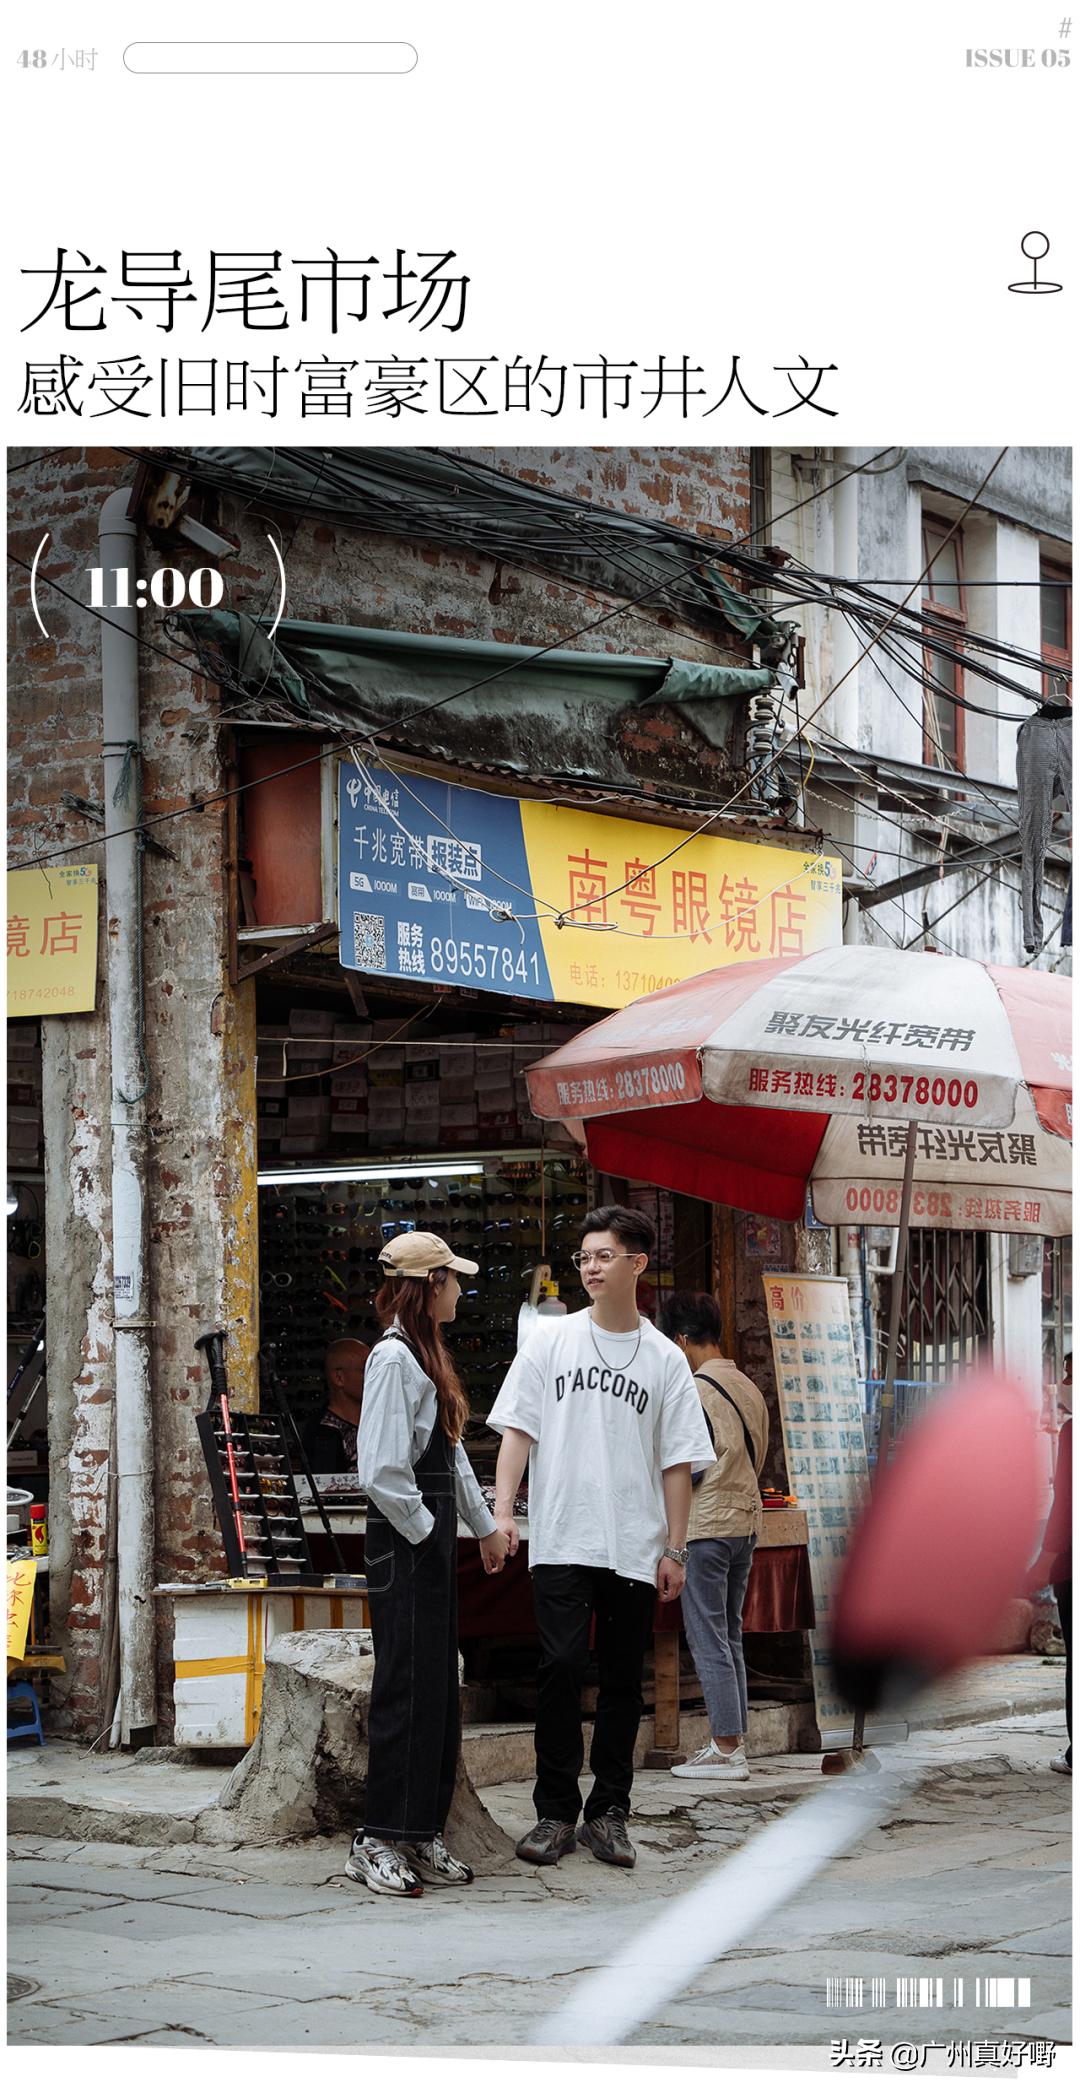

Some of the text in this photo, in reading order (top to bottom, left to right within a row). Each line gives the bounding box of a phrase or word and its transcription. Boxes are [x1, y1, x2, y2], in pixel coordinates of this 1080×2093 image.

[354, 876, 364, 887] 5G
[373, 880, 398, 894] 1000M
[567, 848, 807, 959] 南粤眼镜店
[397, 921, 423, 947] 服务
[398, 947, 426, 974] 热线
[431, 937, 540, 985] 89557841
[764, 1011, 976, 1052] 聚友光纤宽带
[555, 1366, 649, 1415] D'ACCORD
